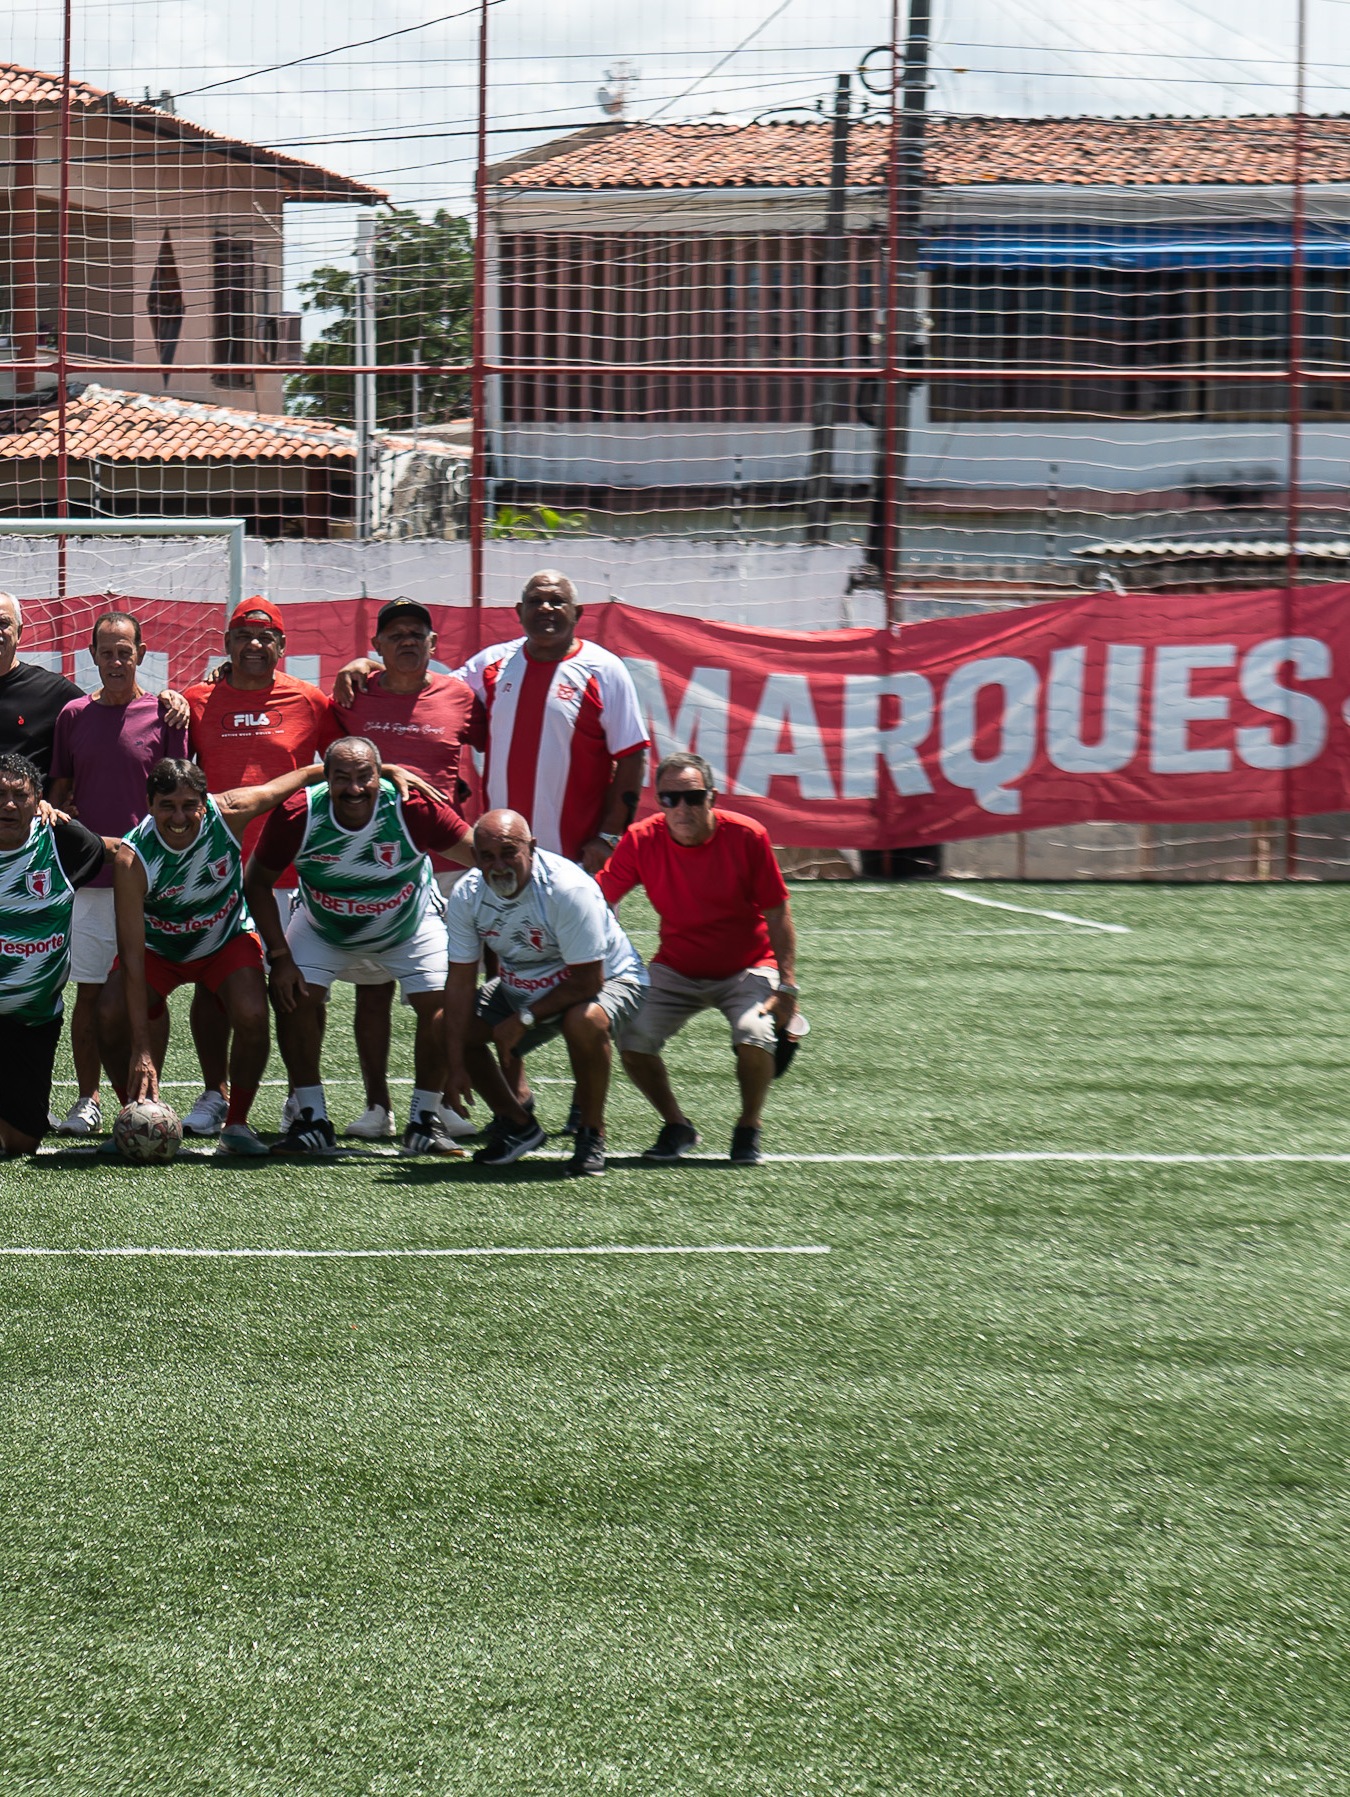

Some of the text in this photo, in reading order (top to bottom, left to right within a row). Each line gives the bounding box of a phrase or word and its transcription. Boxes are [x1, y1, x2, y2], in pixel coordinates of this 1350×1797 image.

[234, 713, 270, 727] FILA
[622, 636, 1333, 814] MARQUES
[322, 883, 414, 915] BETesporte
